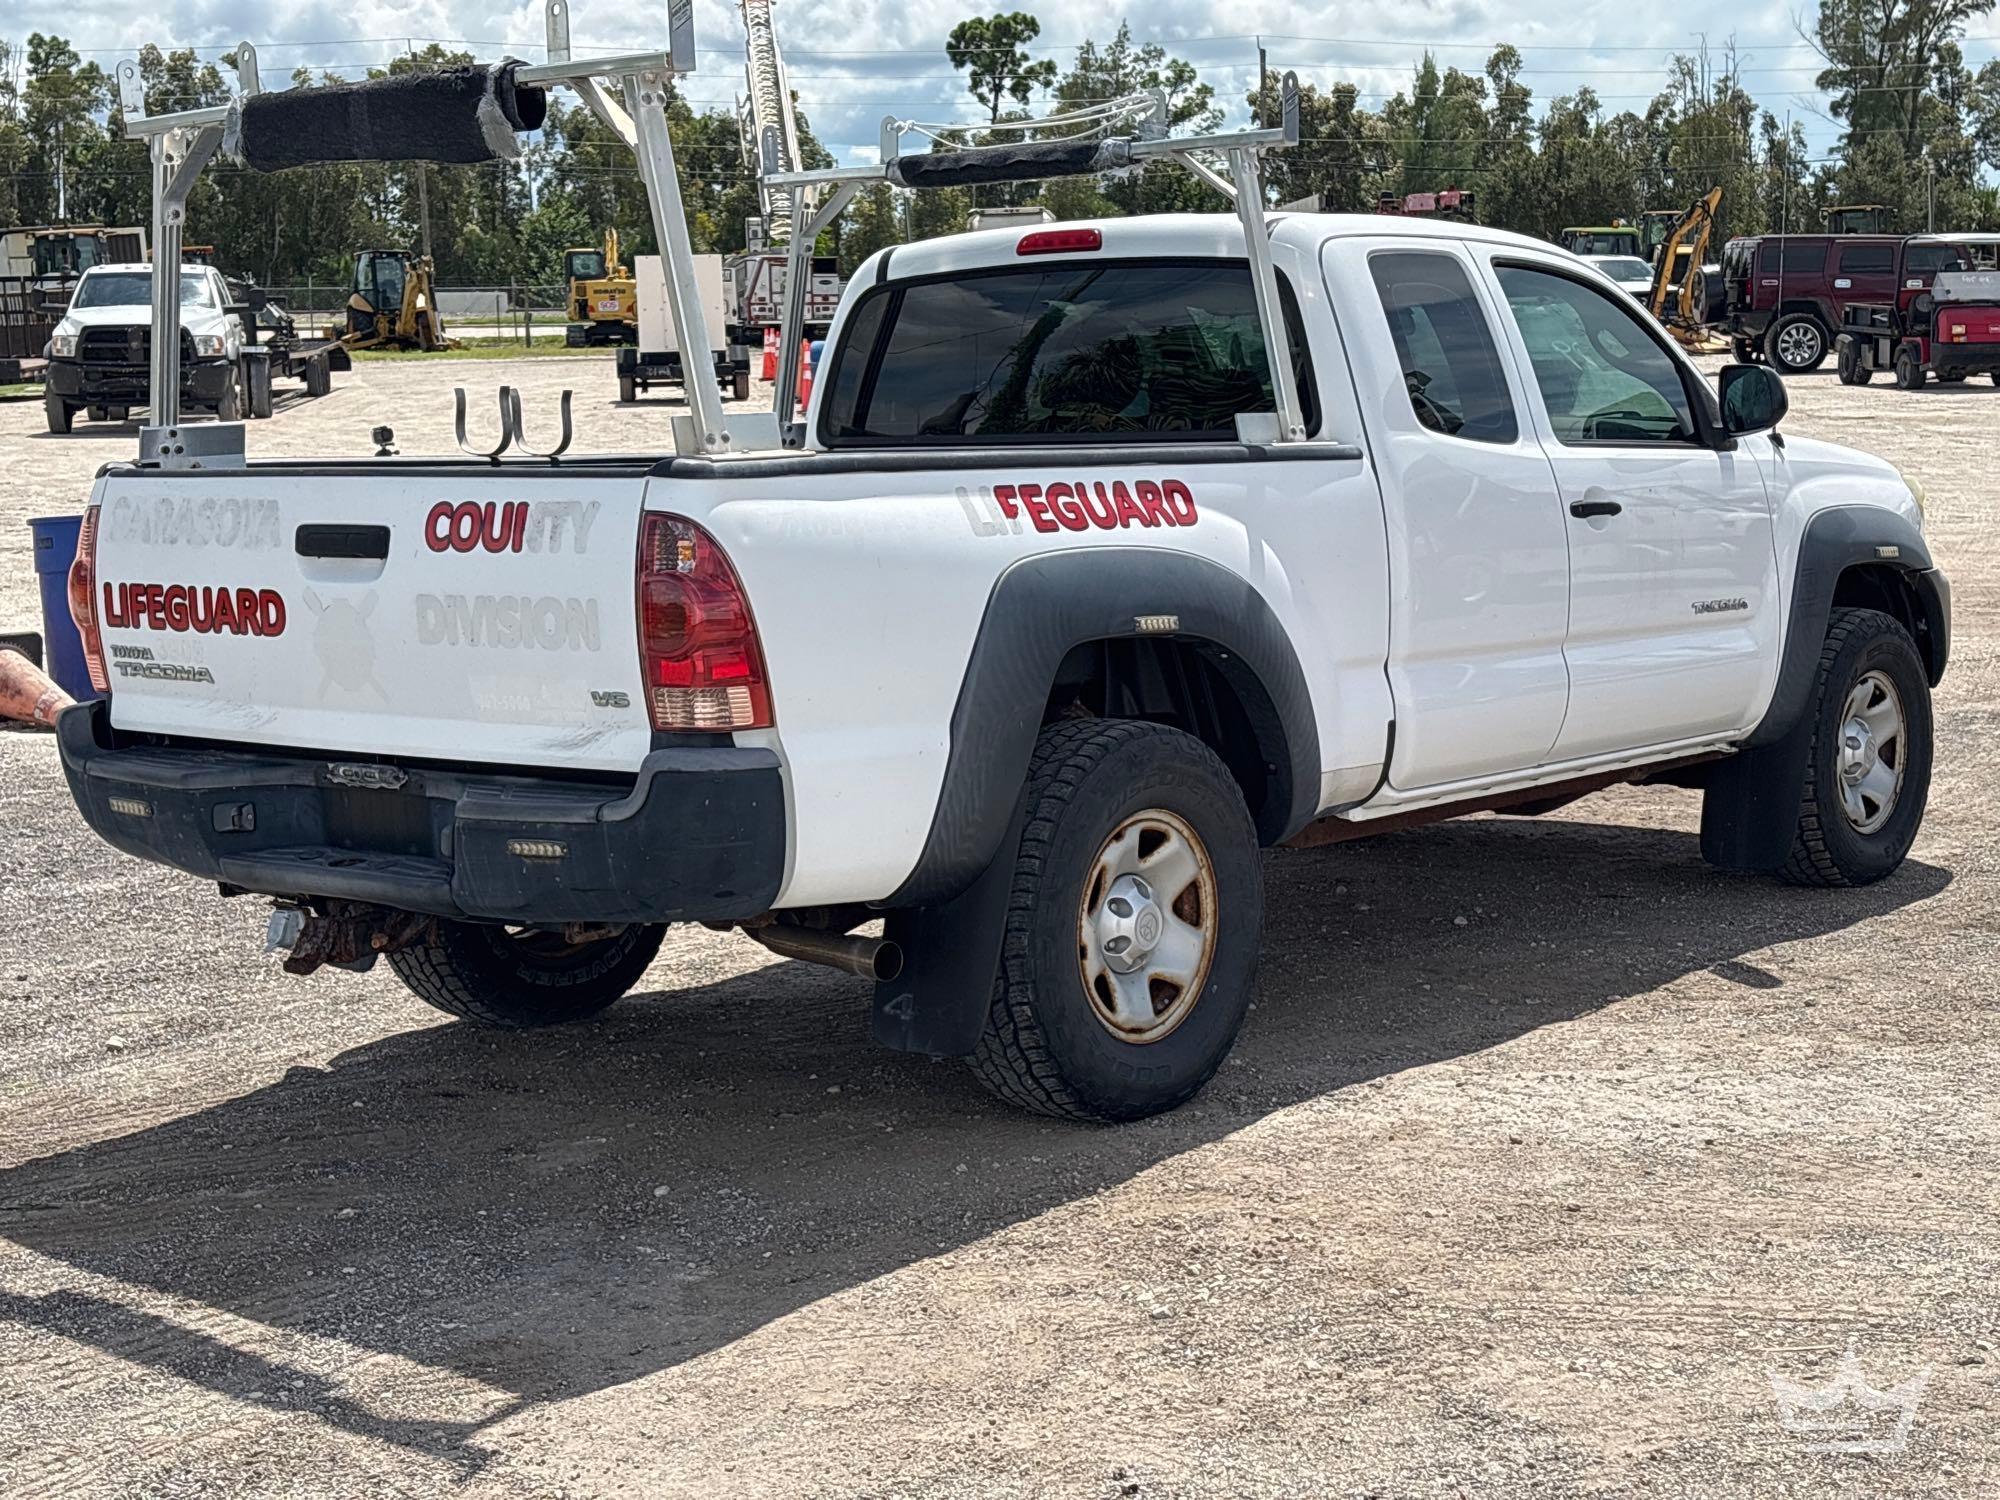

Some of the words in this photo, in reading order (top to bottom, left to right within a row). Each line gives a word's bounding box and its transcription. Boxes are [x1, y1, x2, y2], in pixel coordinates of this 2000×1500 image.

[103, 581, 287, 637] LIFEGUARD
[415, 593, 602, 651] DIVISION
[110, 644, 155, 661] TOYOTA
[113, 661, 215, 684] TACOMA
[591, 690, 631, 708] V6
